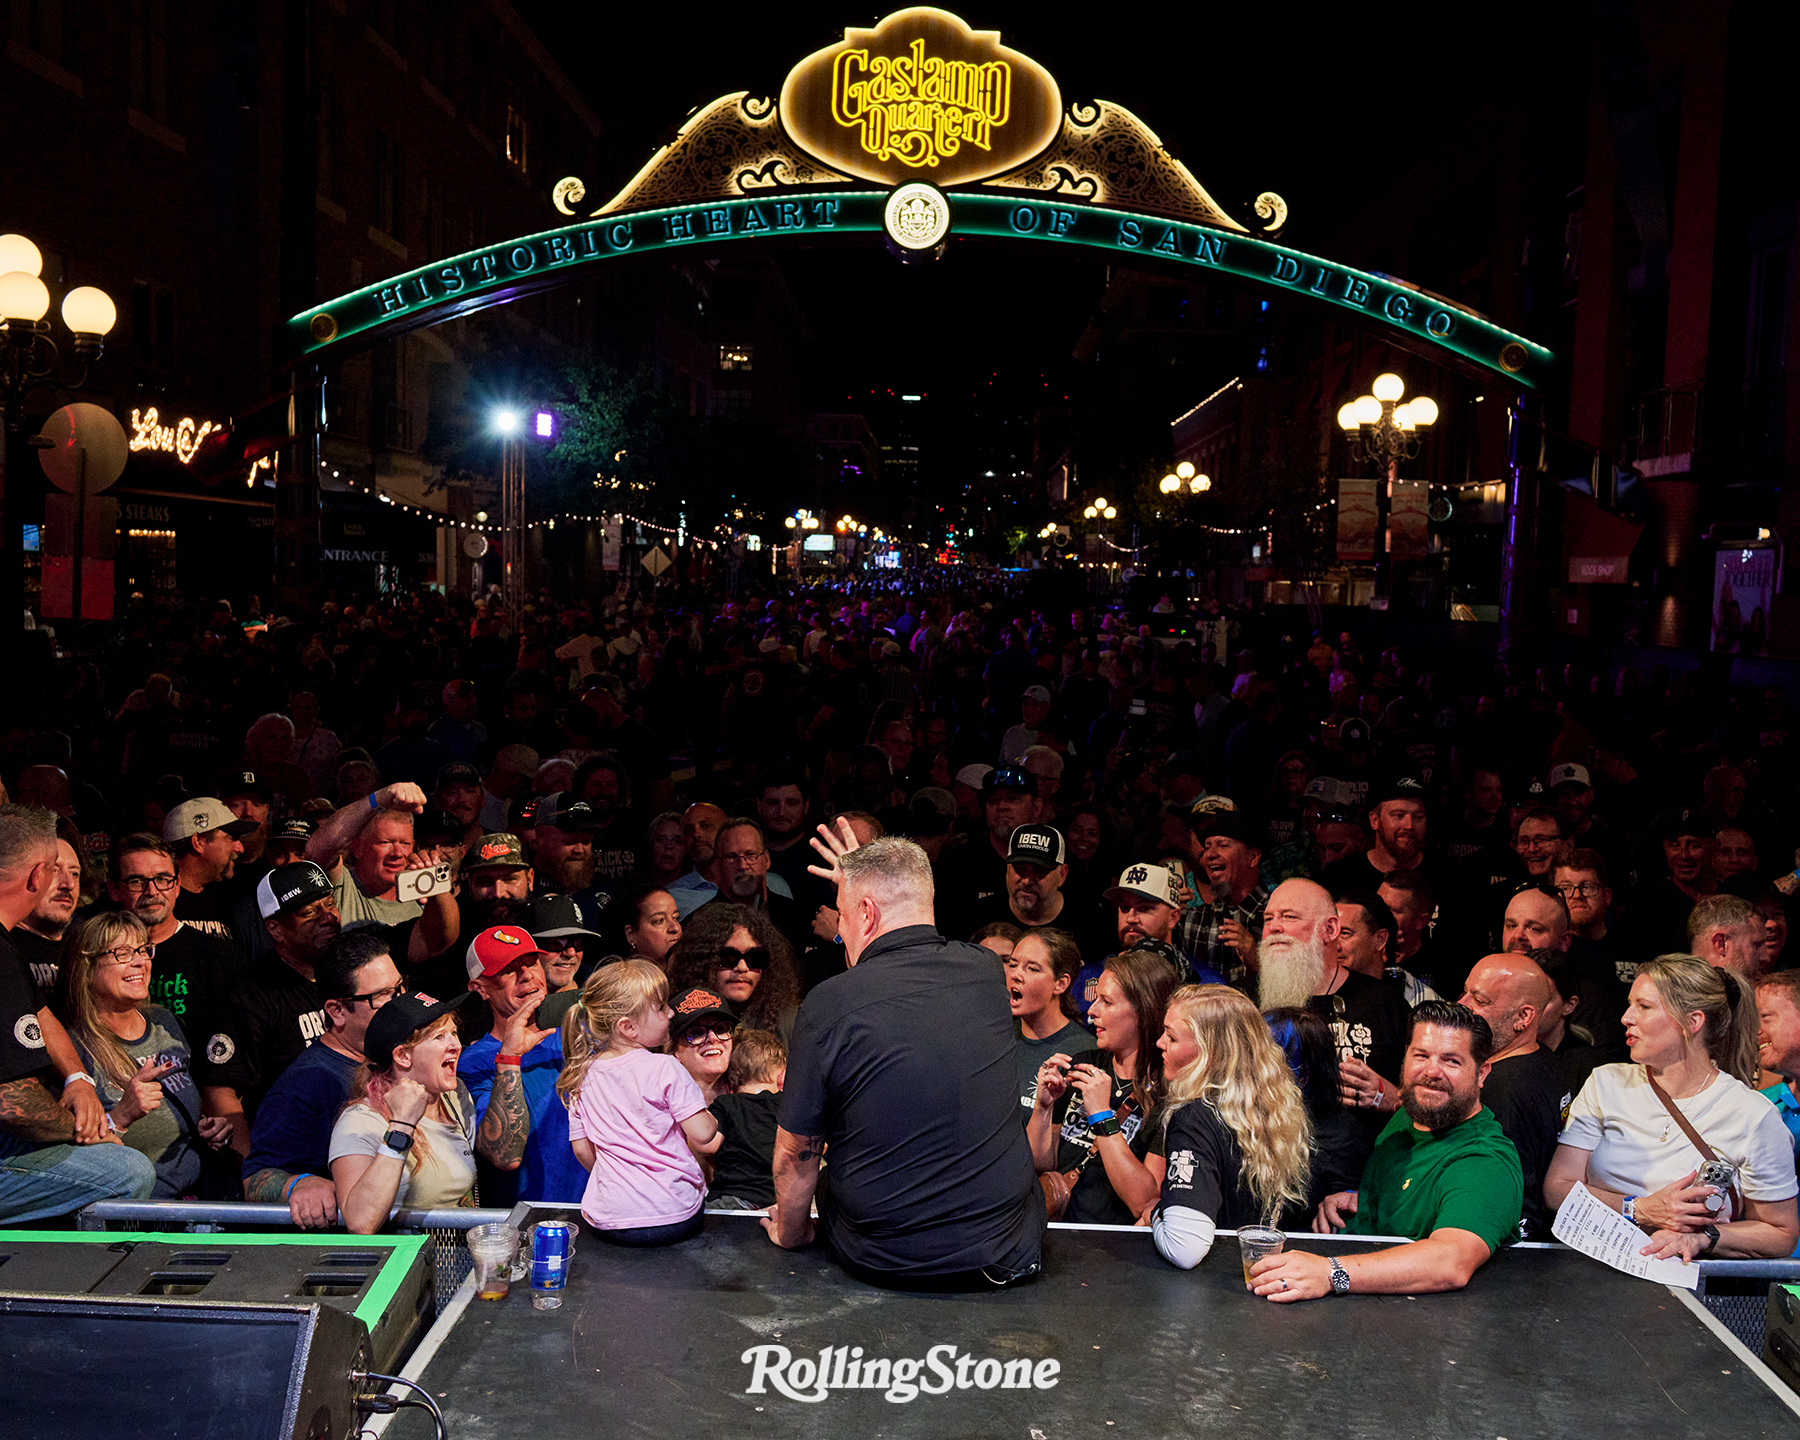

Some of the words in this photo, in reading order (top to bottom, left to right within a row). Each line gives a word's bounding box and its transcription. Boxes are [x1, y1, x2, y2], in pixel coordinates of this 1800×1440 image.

[832, 38, 1011, 127] Gaslamp
[372, 220, 633, 318] HISTORIC
[663, 199, 839, 243] HEART
[1009, 205, 1078, 237] OF
[1117, 219, 1228, 265] SAN
[1271, 253, 1457, 338] DIEGO
[126, 503, 170, 522] STEAKS
[1019, 833, 1051, 847] IBEW
